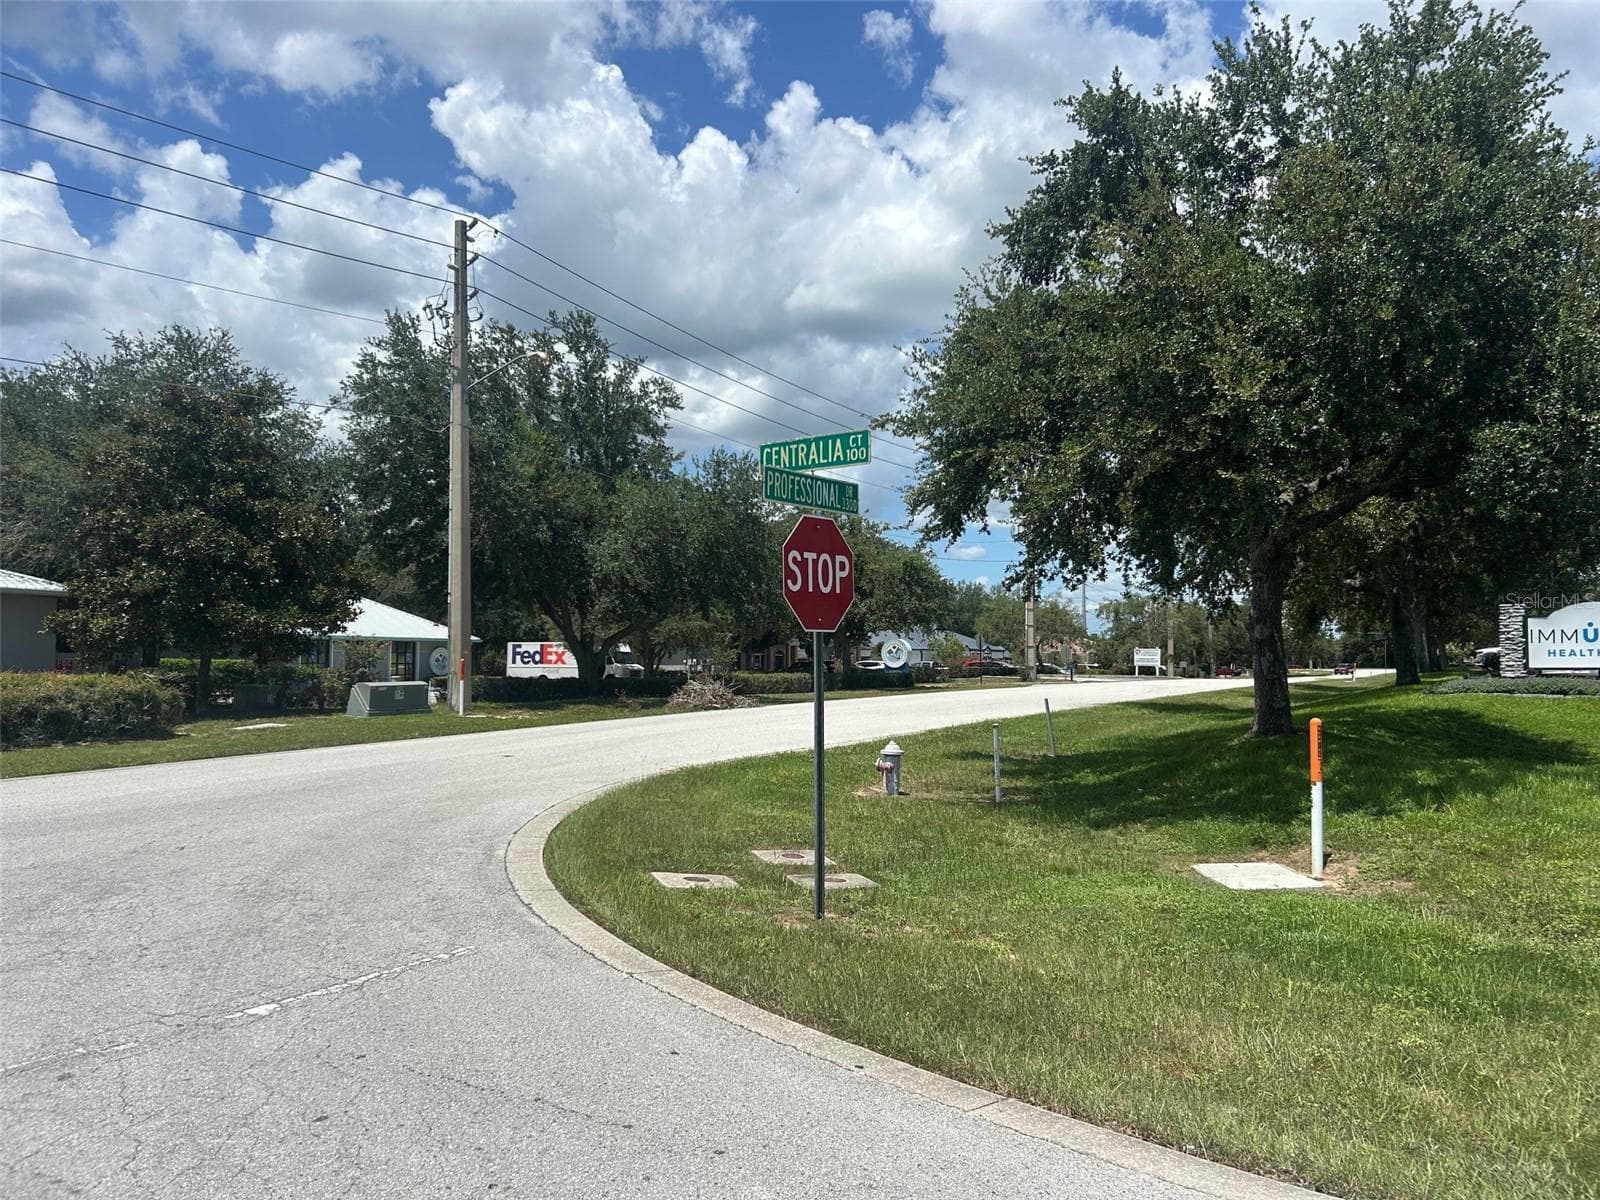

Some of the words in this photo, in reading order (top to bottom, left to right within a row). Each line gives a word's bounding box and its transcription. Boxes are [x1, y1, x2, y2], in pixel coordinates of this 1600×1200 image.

[763, 438, 843, 469] CENTRALIA
[849, 434, 863, 448] CT
[847, 448, 866, 461] 100
[767, 470, 841, 508] PROFESSIONAL
[787, 549, 850, 594] STOP
[511, 643, 567, 665] FedEx
